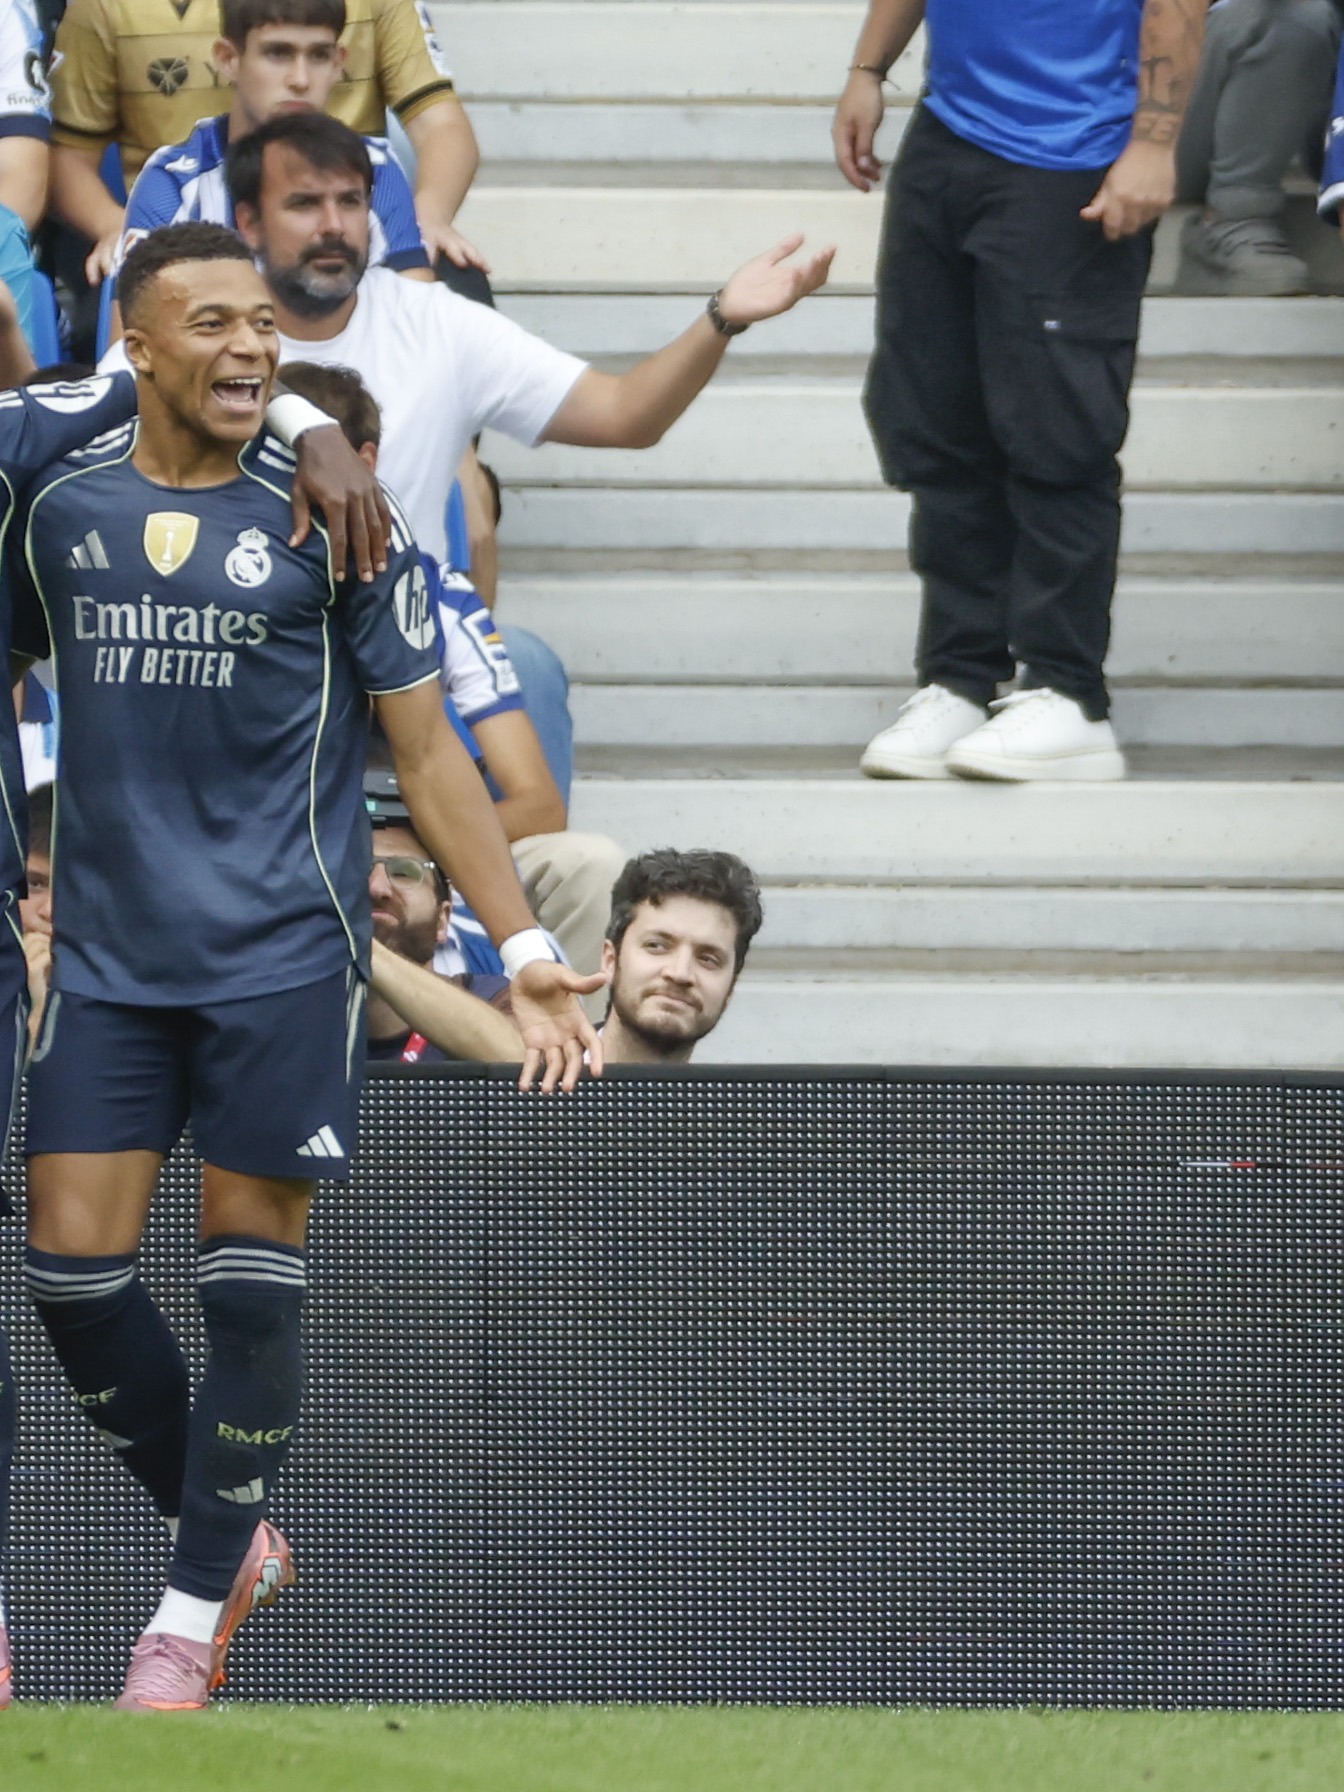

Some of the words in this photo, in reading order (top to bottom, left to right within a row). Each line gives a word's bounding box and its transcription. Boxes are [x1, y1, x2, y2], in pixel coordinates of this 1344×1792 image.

[72, 593, 269, 646] Emirates
[93, 646, 134, 684] FLY
[140, 647, 236, 688] BETTER
[217, 1421, 294, 1445] RMCF
